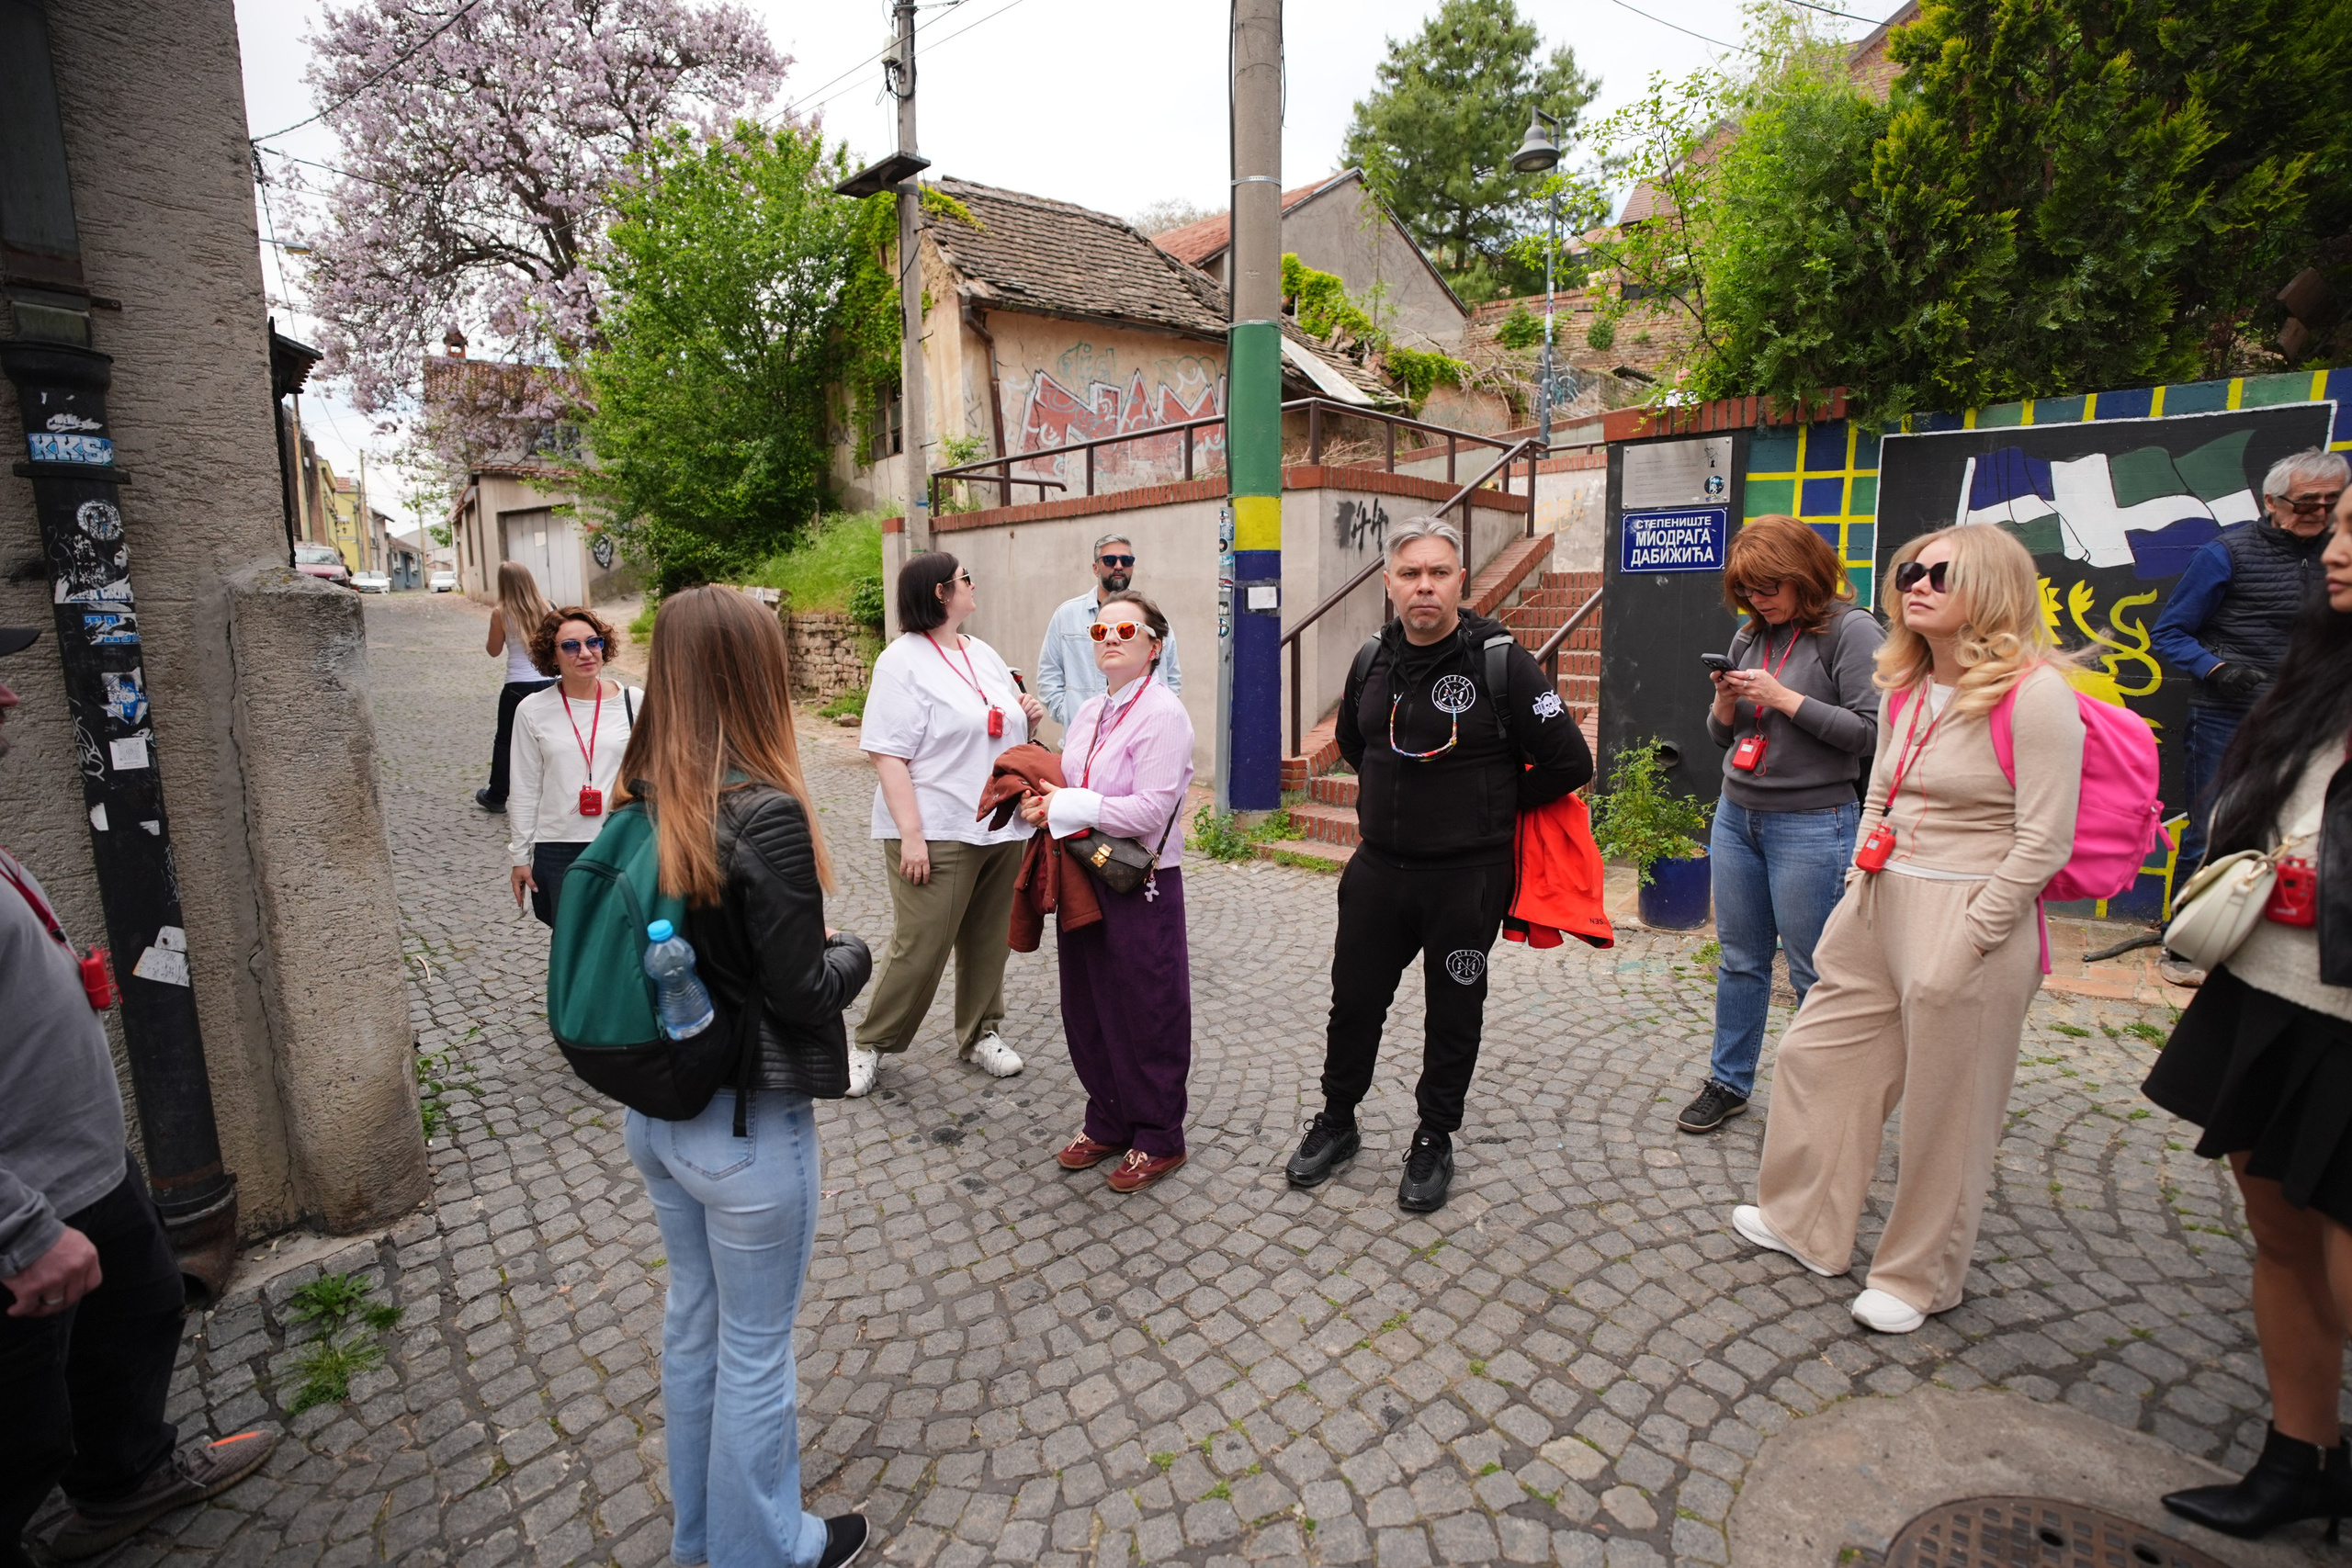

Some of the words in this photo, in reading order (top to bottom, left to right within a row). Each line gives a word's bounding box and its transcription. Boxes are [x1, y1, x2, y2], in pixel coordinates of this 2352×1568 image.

[1636, 516, 1712, 529] СТЕПЕНИШТЕ
[1635, 528, 1712, 547] МИОДРАГА
[1631, 547, 1714, 567] ДАБИЖИЋА
